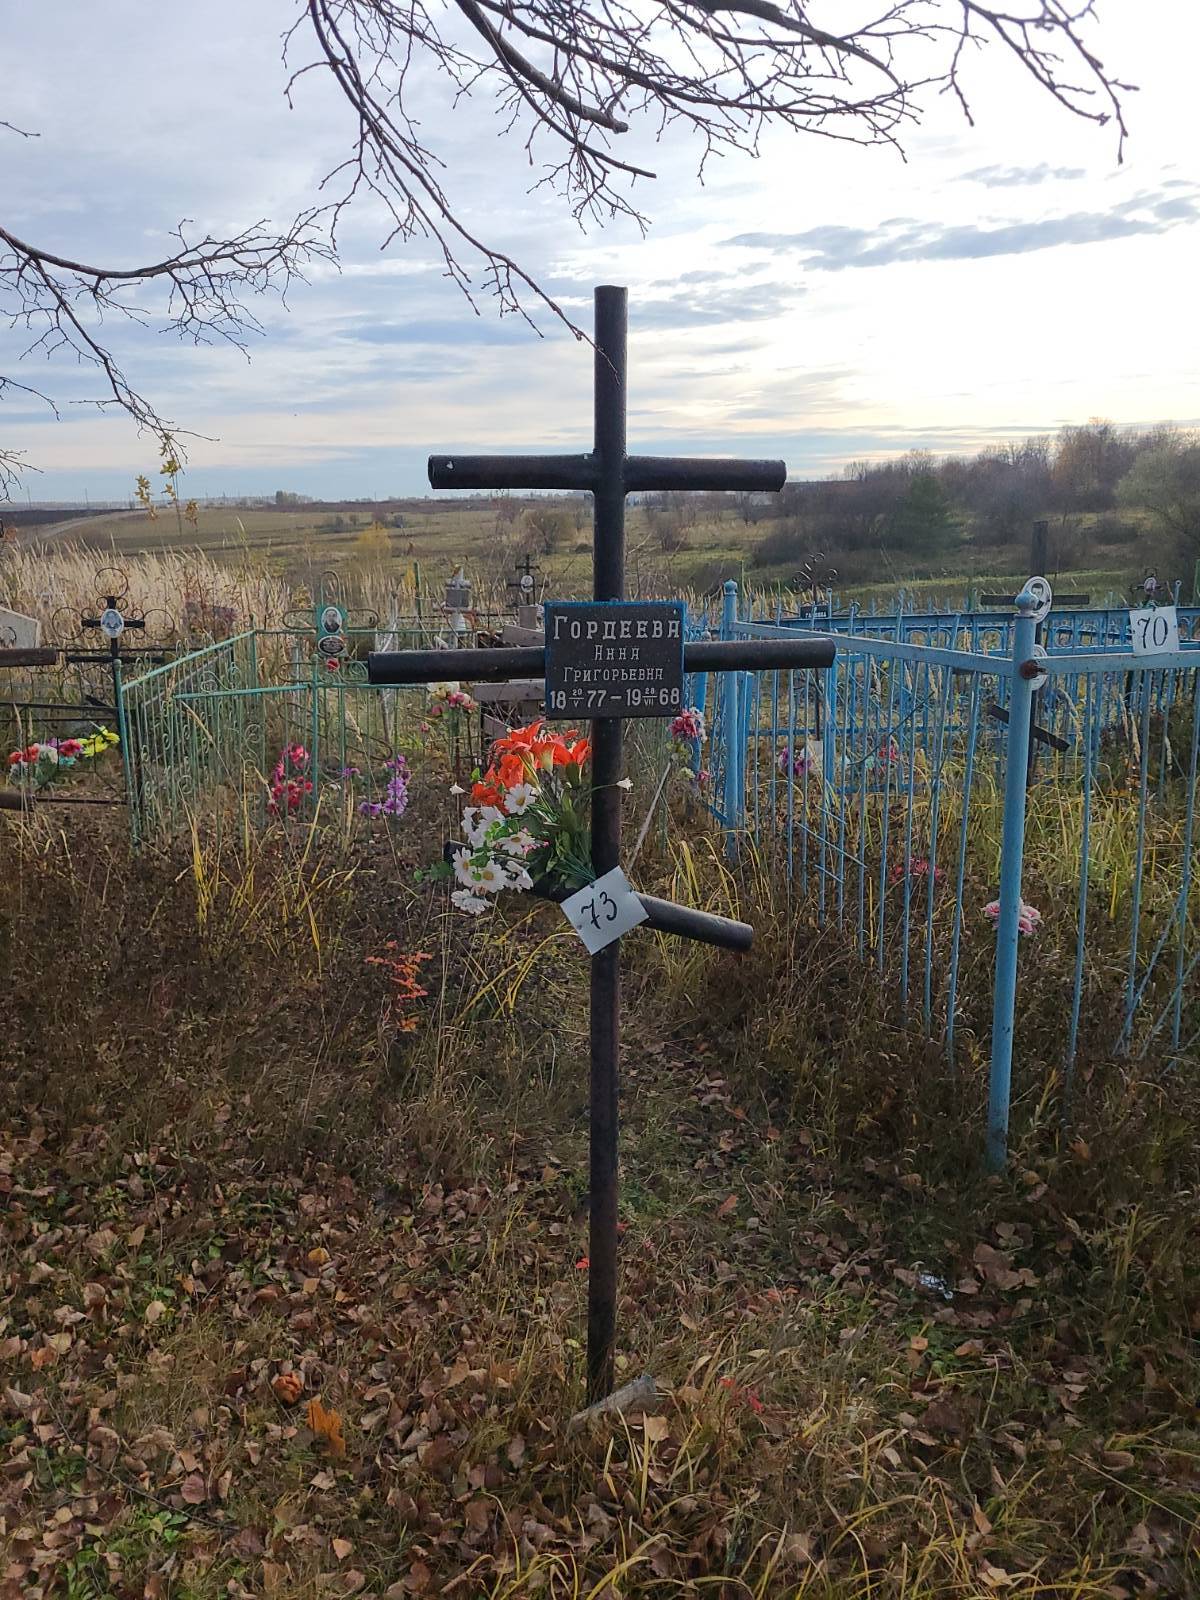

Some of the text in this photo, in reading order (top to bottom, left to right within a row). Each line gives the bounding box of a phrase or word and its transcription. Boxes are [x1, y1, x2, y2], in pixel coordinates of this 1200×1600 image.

[553, 615, 681, 640] ГОРДЕЕВА
[1137, 616, 1168, 649] 70
[594, 644, 640, 661] АННА
[563, 667, 664, 682] ГРИГОРЬЕВНА
[581, 891, 618, 929] 73
